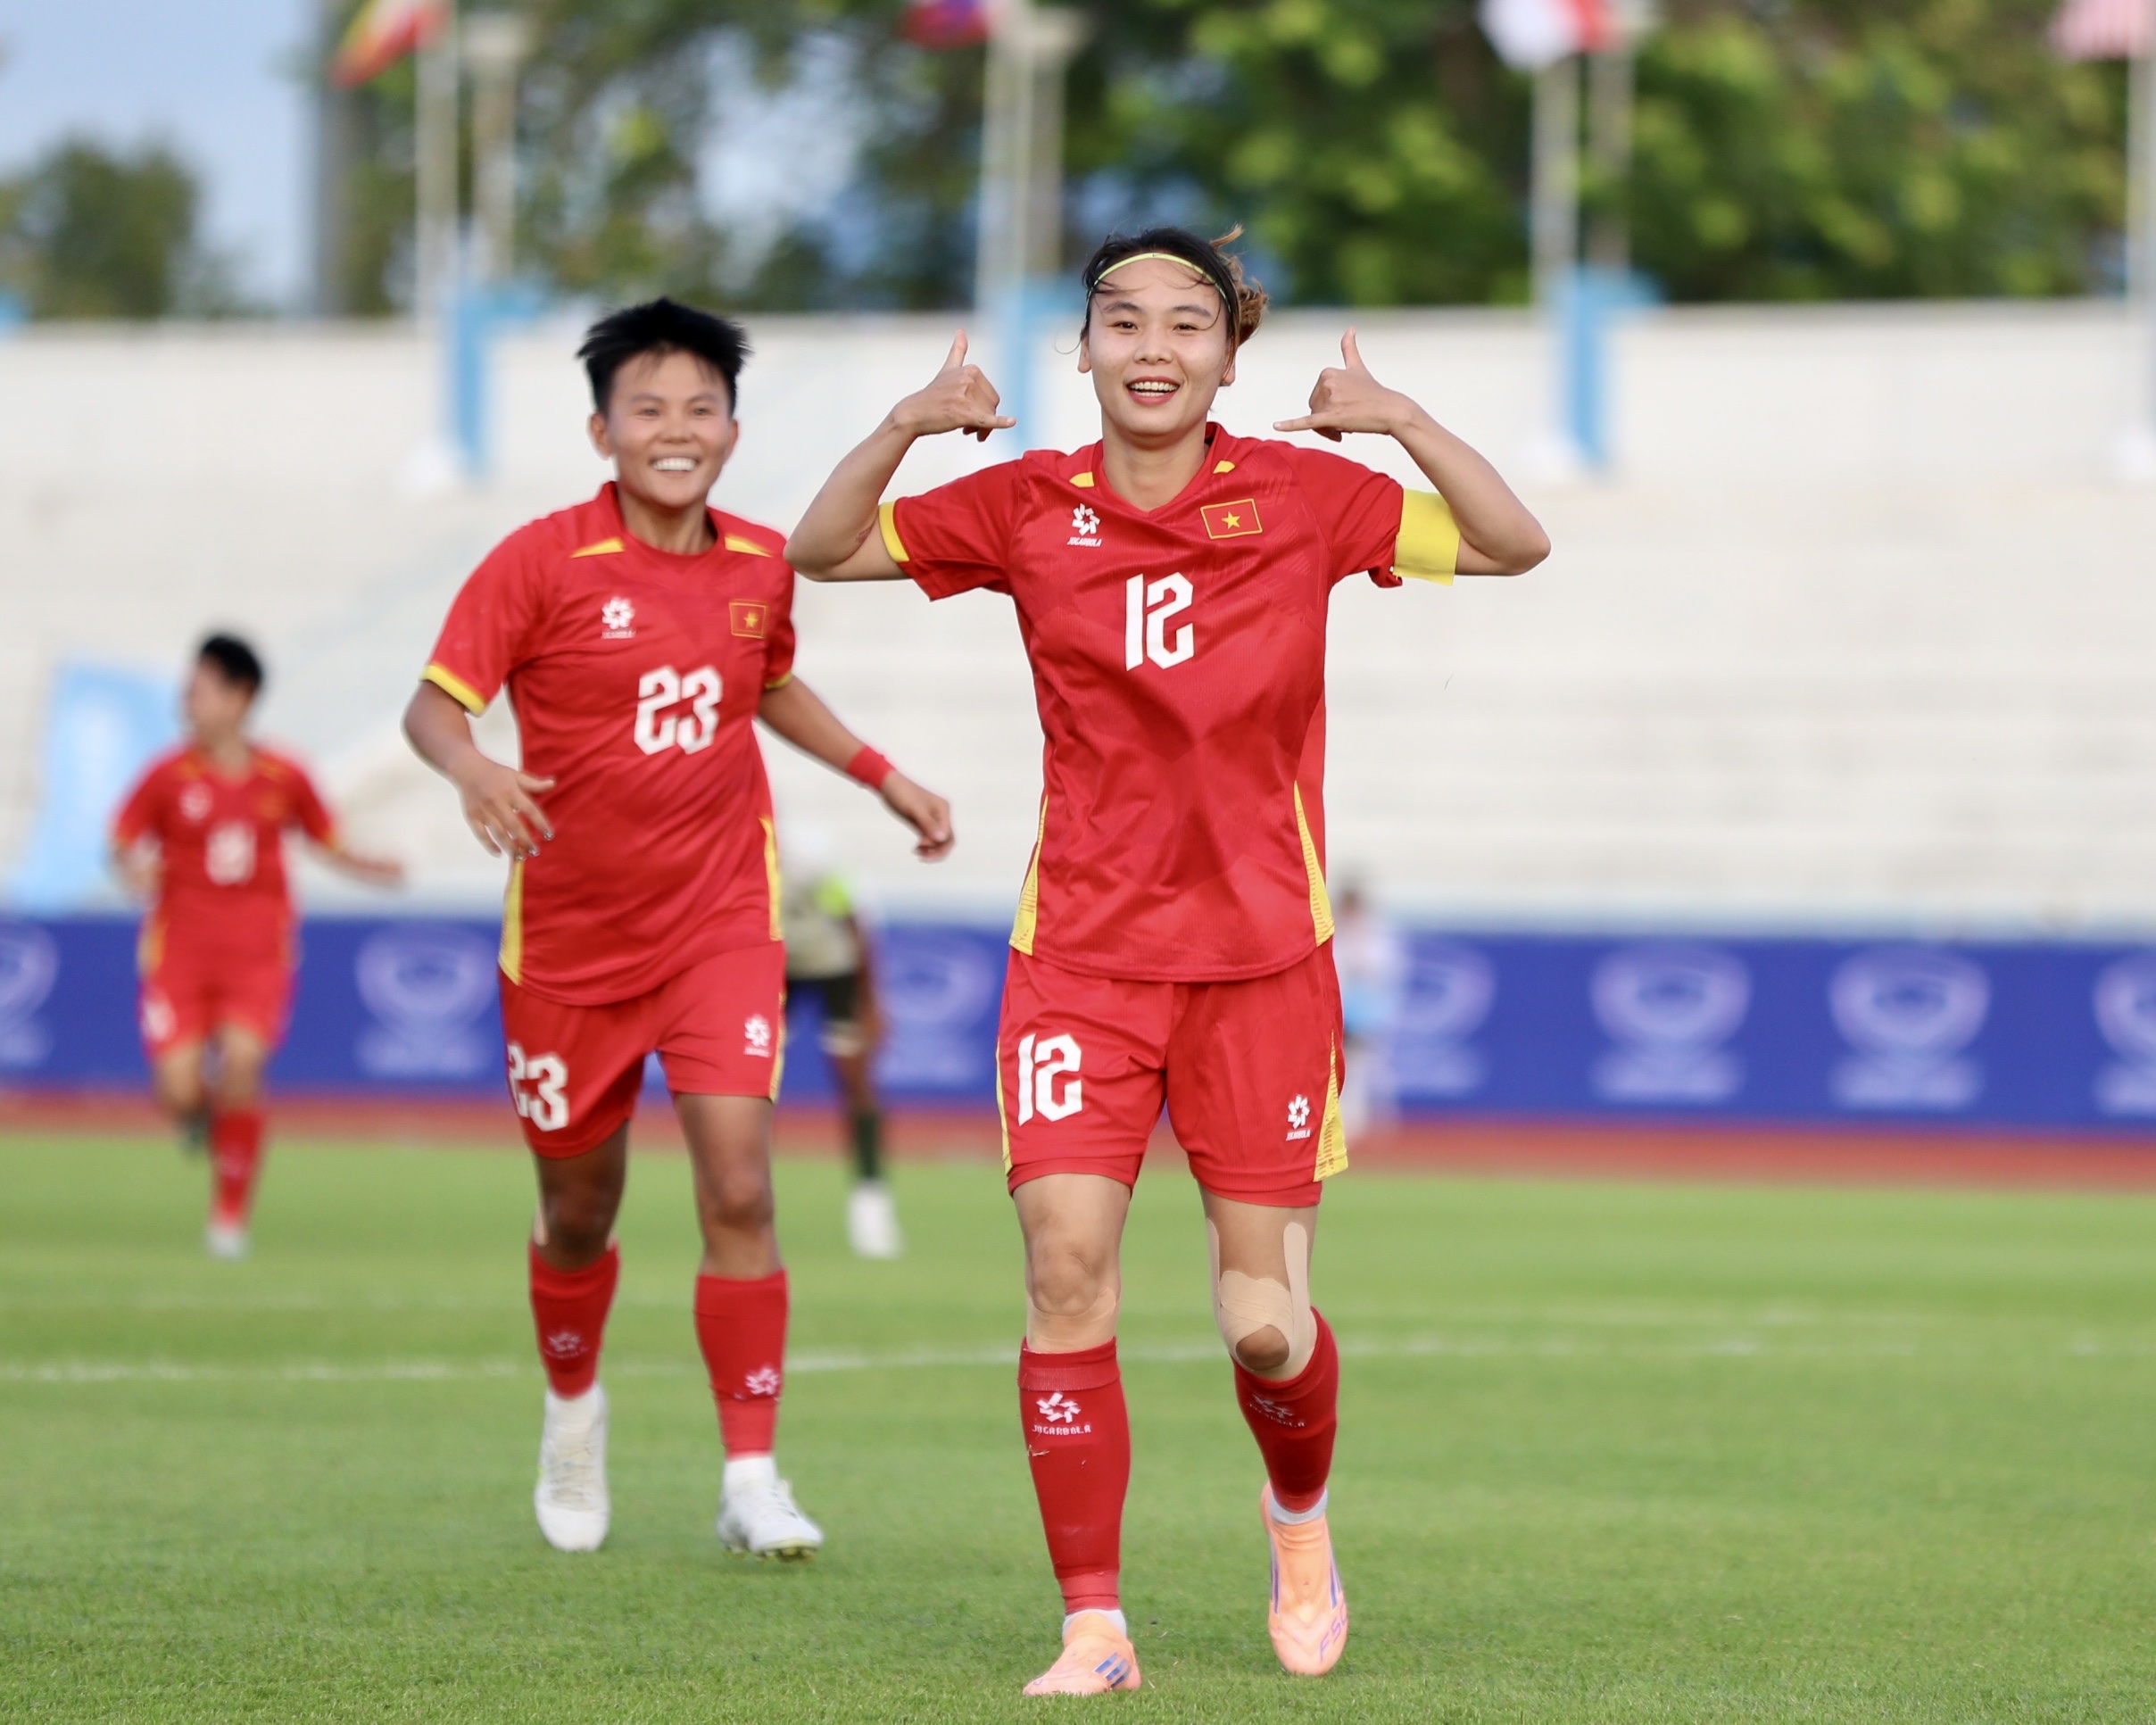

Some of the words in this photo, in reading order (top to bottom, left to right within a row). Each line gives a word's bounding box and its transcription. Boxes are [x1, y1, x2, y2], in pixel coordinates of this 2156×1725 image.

[1125, 572, 1194, 671] 12
[634, 667, 722, 755] 23
[1017, 1033, 1082, 1126] 12
[1032, 1424, 1091, 1435] JOGARBOLA
